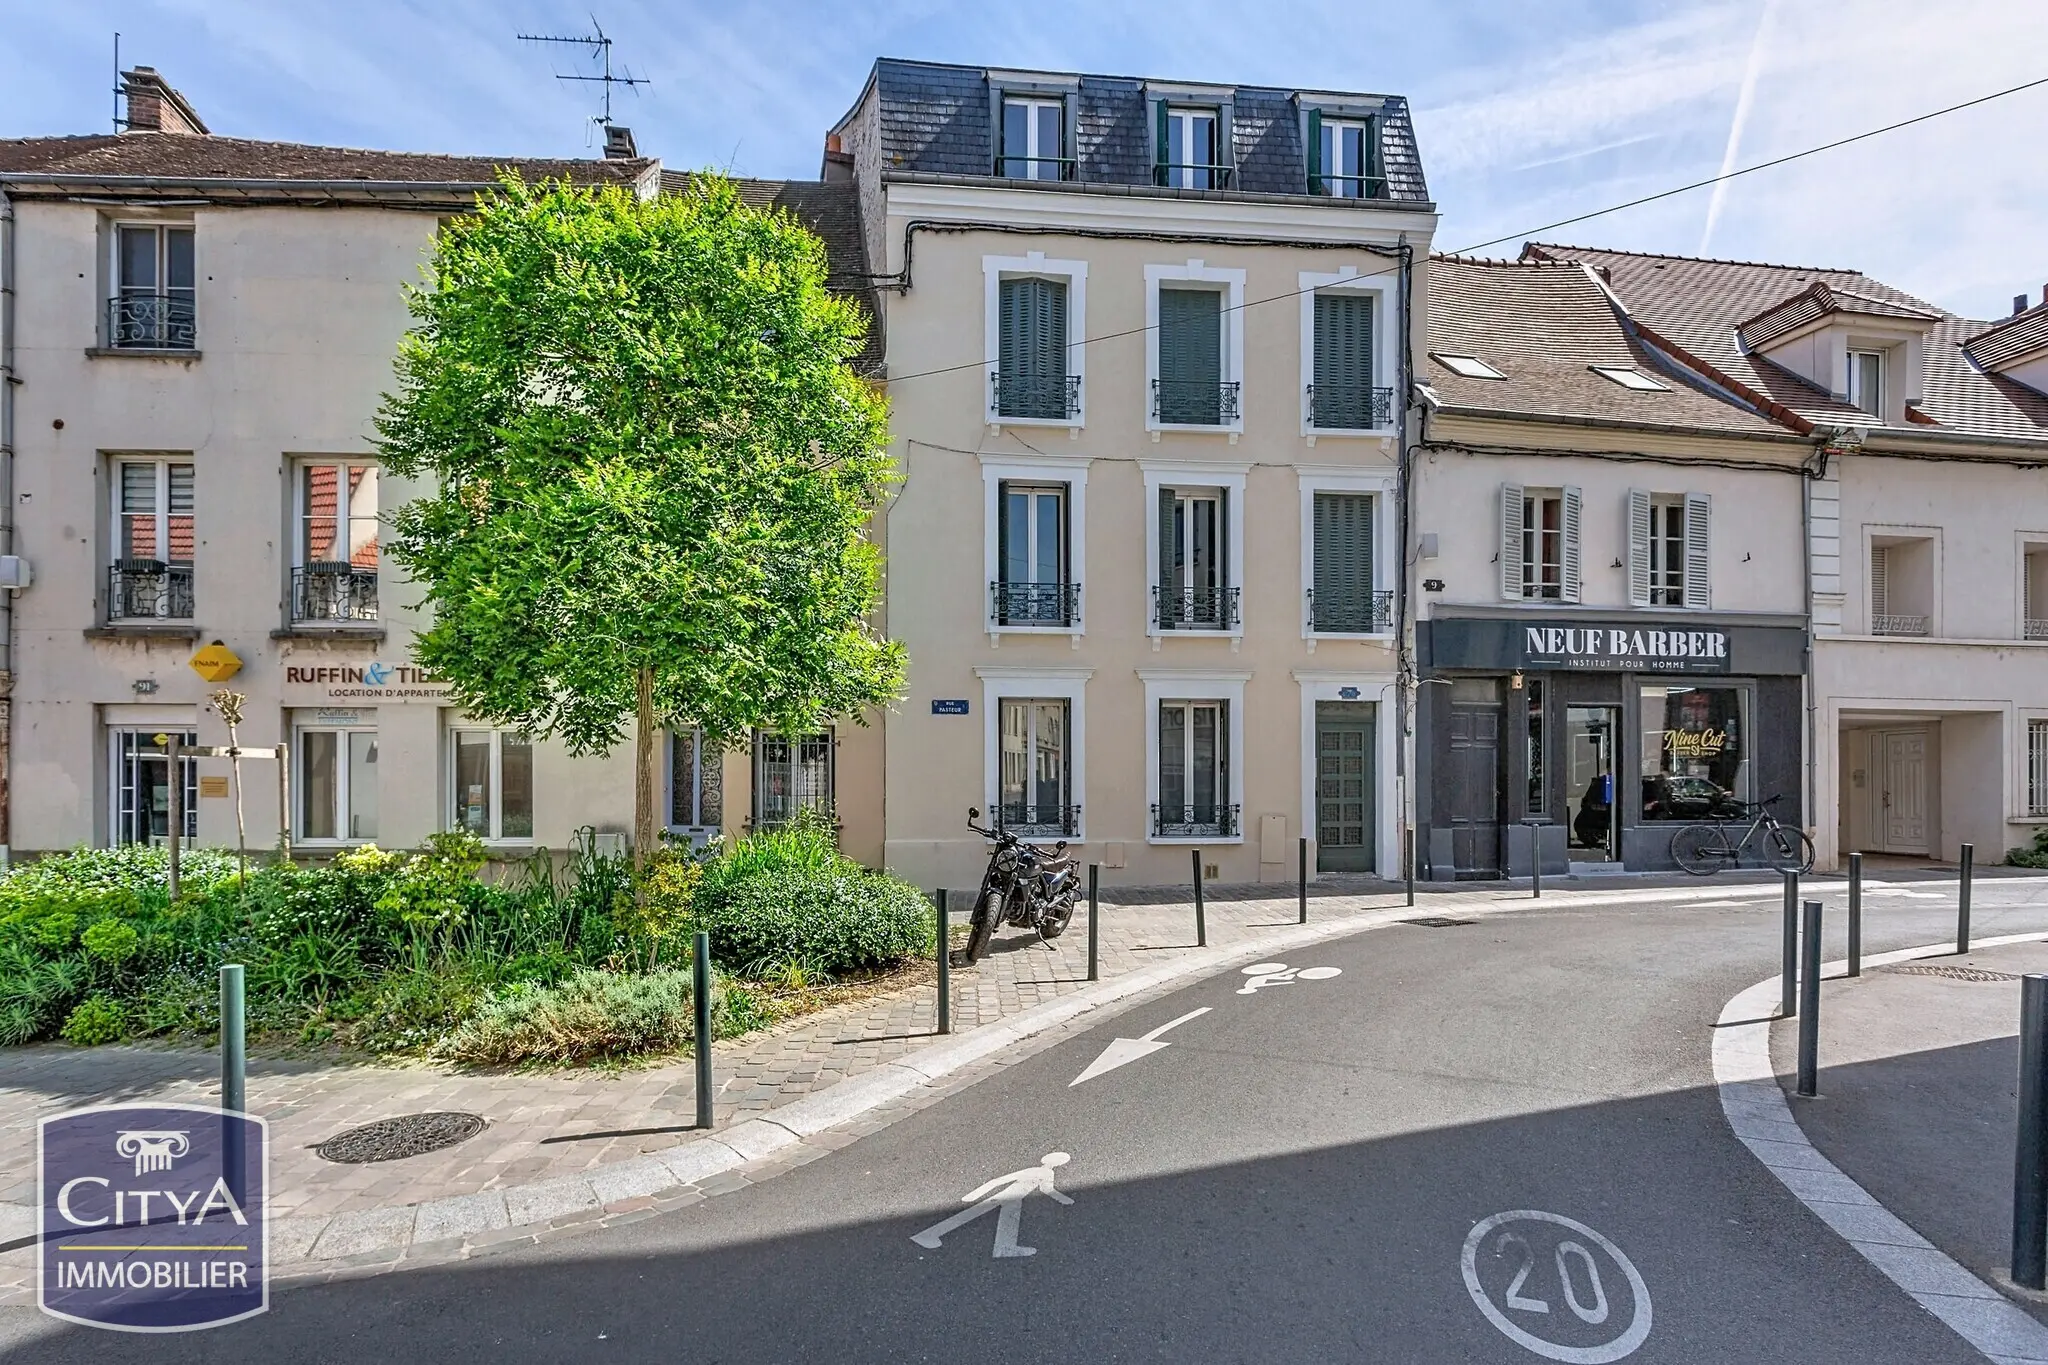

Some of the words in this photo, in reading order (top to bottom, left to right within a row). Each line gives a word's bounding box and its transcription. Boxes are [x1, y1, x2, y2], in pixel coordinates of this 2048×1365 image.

[1431, 581, 1437, 589] 9
[1525, 627, 1603, 654] NEUF
[1608, 629, 1727, 658] BARBER
[1568, 659, 1611, 667] INSTITUT
[1619, 660, 1644, 668] POUR
[1652, 661, 1685, 669] HOMME
[287, 667, 363, 683] RUFFIN
[364, 662, 395, 685] &
[139, 682, 150, 691] 91
[328, 689, 382, 697] LOCATION
[1663, 728, 1700, 750] Nine
[1700, 728, 1726, 747] Cut
[1496, 1232, 1609, 1324] 20
